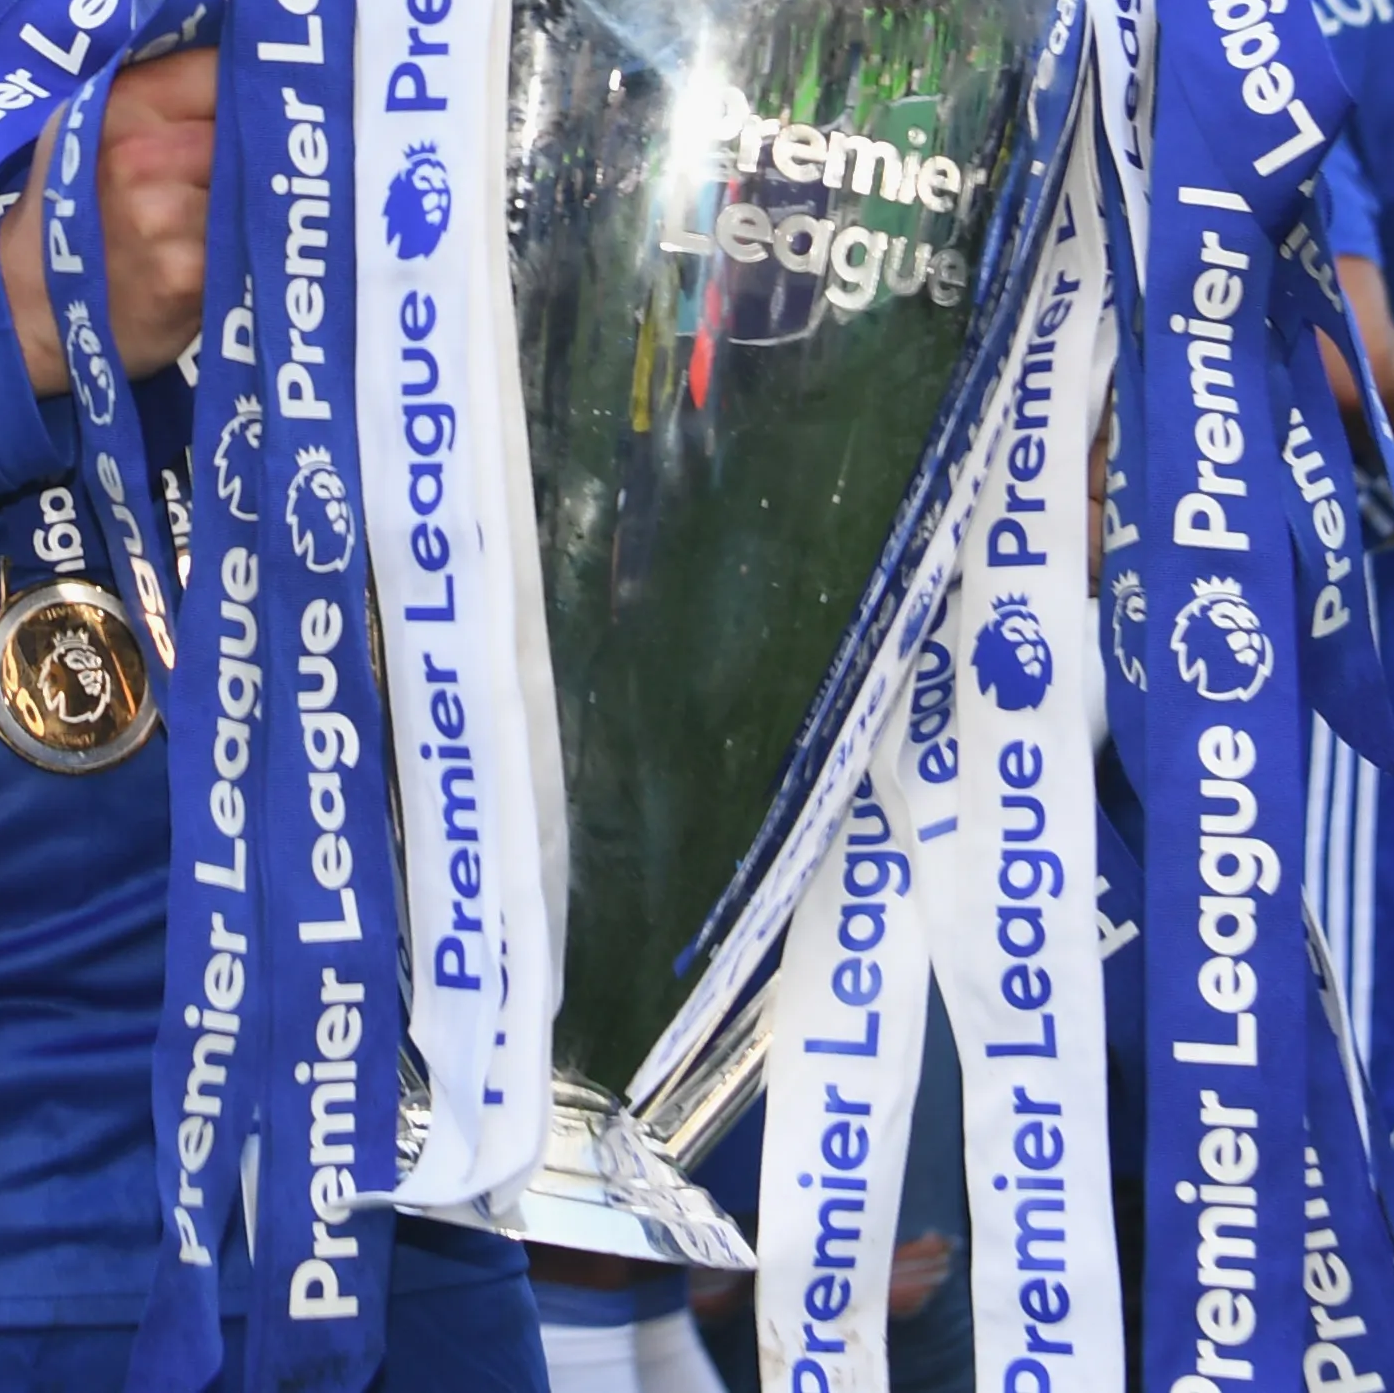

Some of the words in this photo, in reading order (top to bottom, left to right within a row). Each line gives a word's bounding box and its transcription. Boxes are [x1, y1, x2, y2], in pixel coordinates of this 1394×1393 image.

[273, 87, 331, 422] Premier
[1170, 230, 1251, 552] Premier
[400, 289, 456, 622] League
[195, 546, 263, 892] League
[297, 599, 361, 944] League
[420, 651, 485, 991] Premier
[986, 739, 1065, 1059] League
[1173, 725, 1281, 1066] League
[178, 913, 248, 1266] Premier
[288, 967, 366, 1320] Premier
